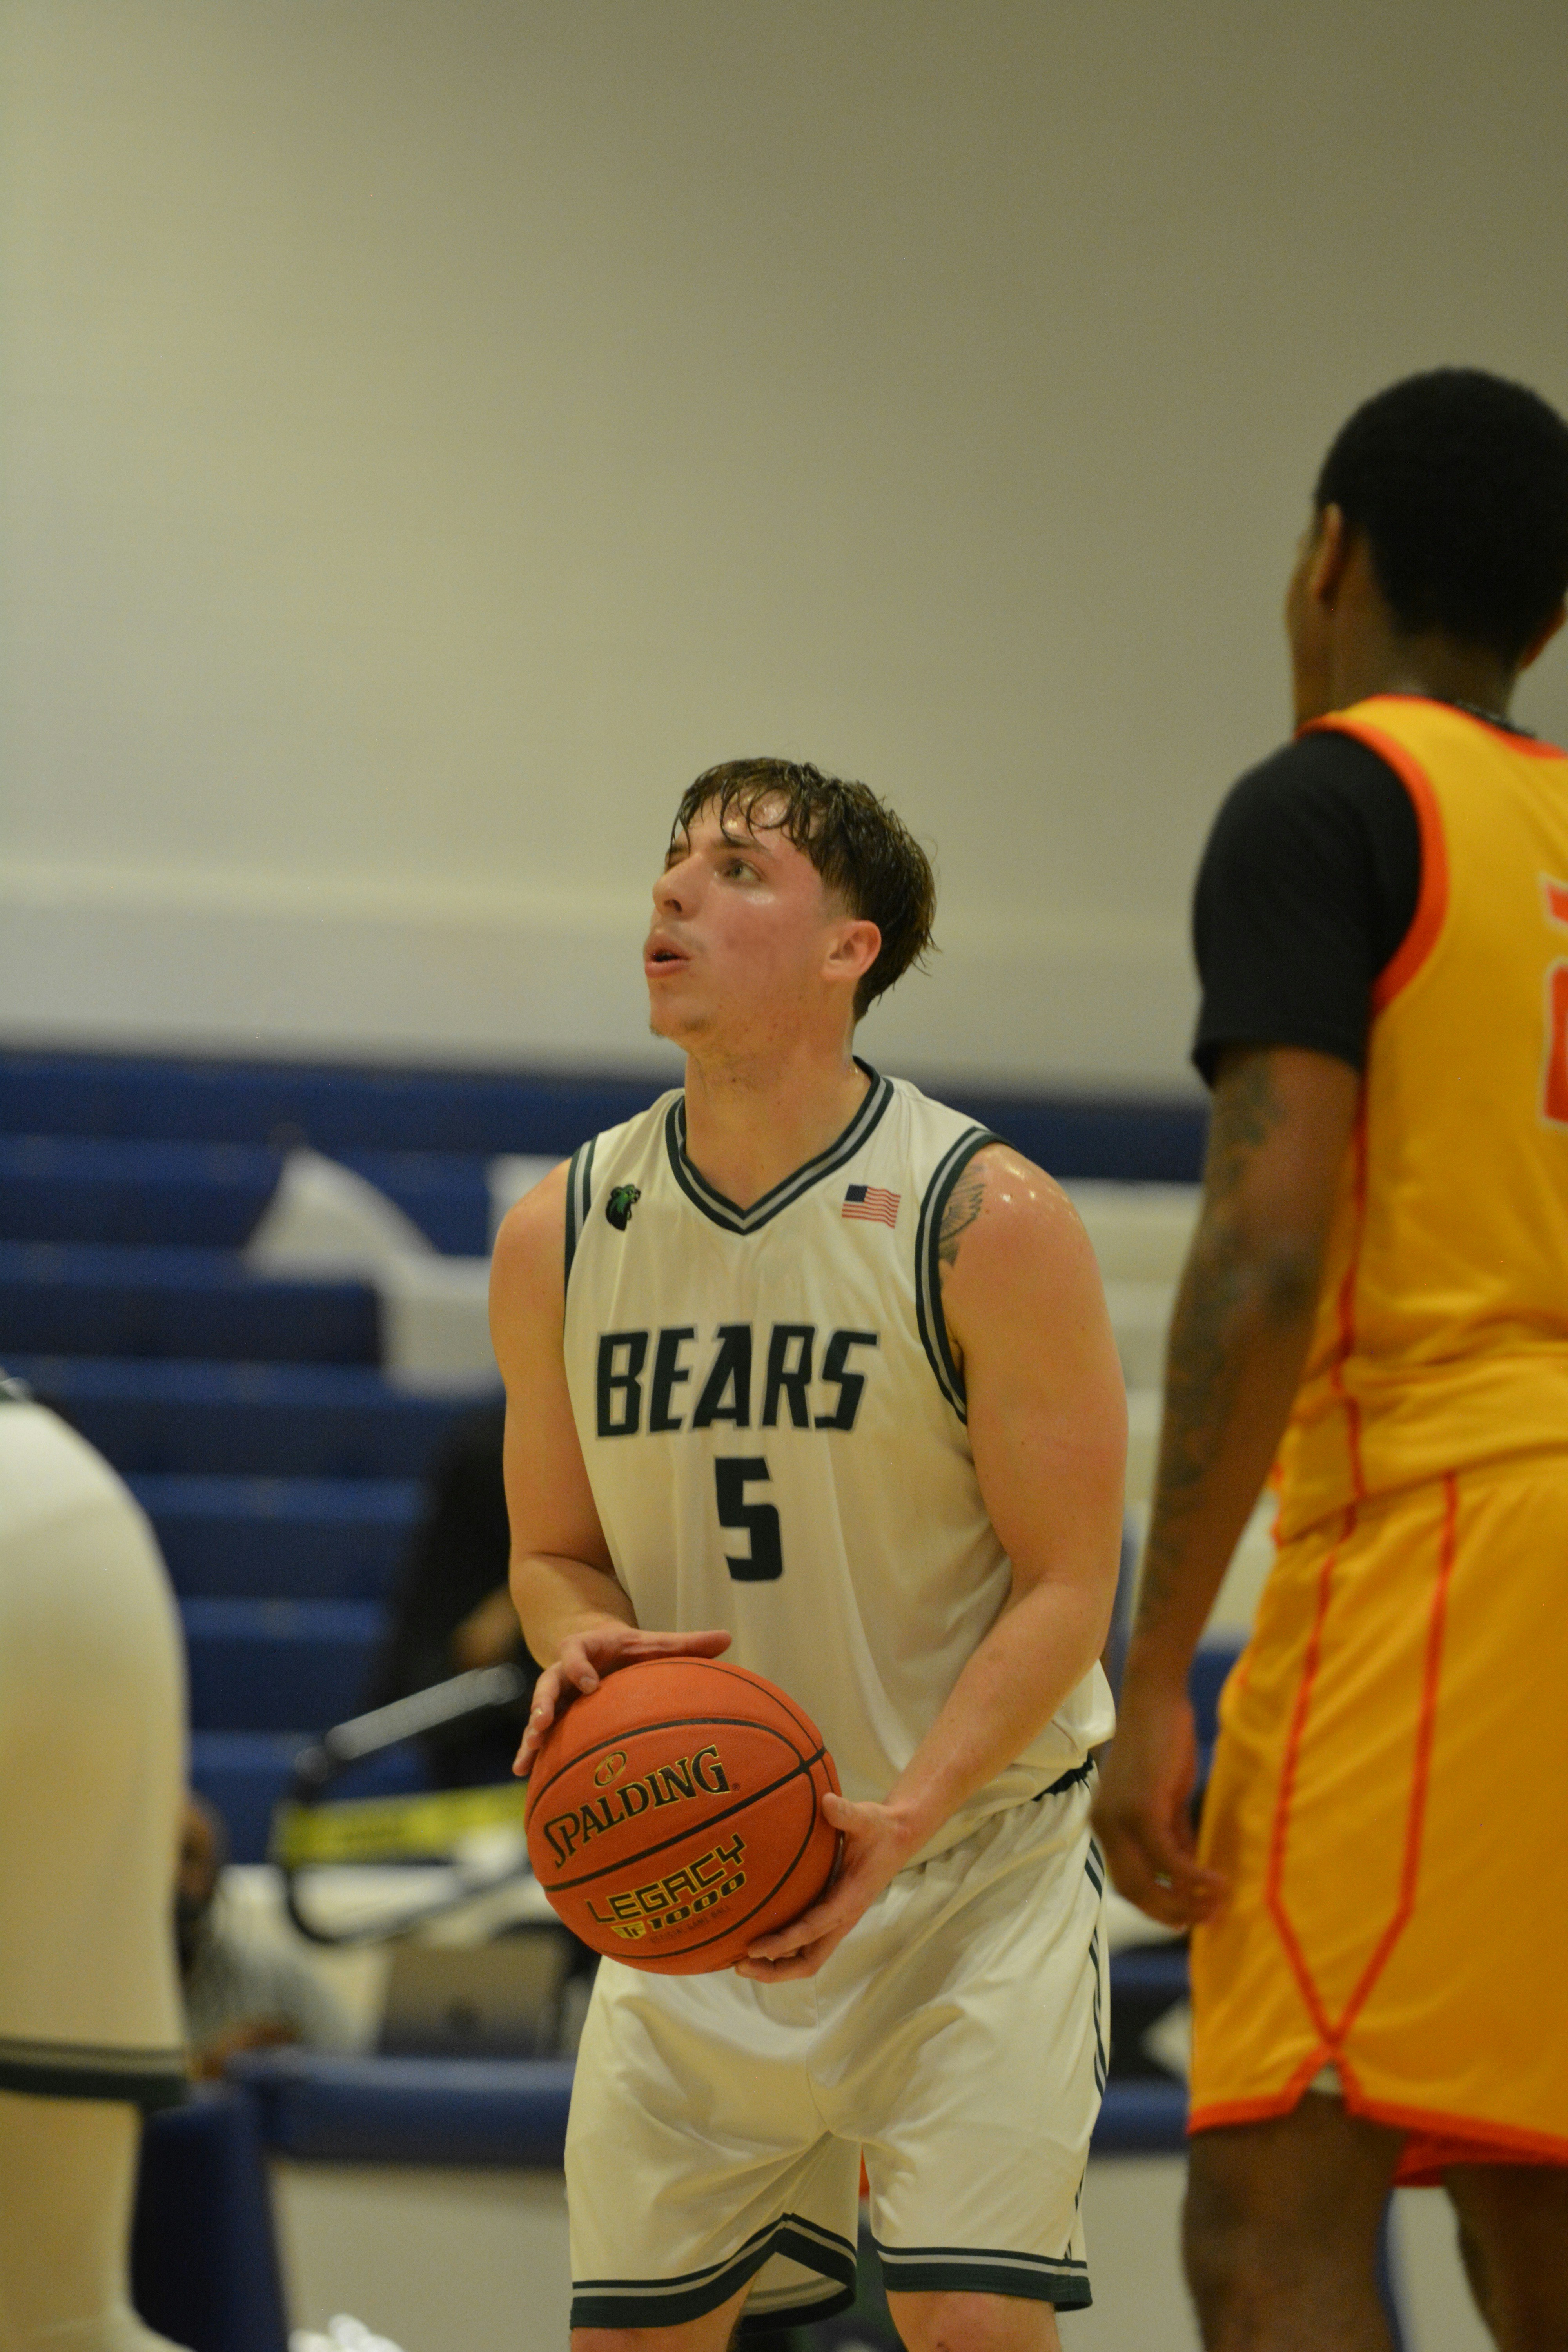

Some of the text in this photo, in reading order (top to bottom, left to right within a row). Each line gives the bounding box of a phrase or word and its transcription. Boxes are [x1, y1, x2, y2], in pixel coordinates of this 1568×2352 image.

[595, 1320, 878, 1440] BEARS
[713, 1455, 783, 1582] 5
[543, 1744, 731, 1870] SPALDING
[584, 1832, 746, 1924] LEGACY
[647, 1871, 746, 1931] 1000
